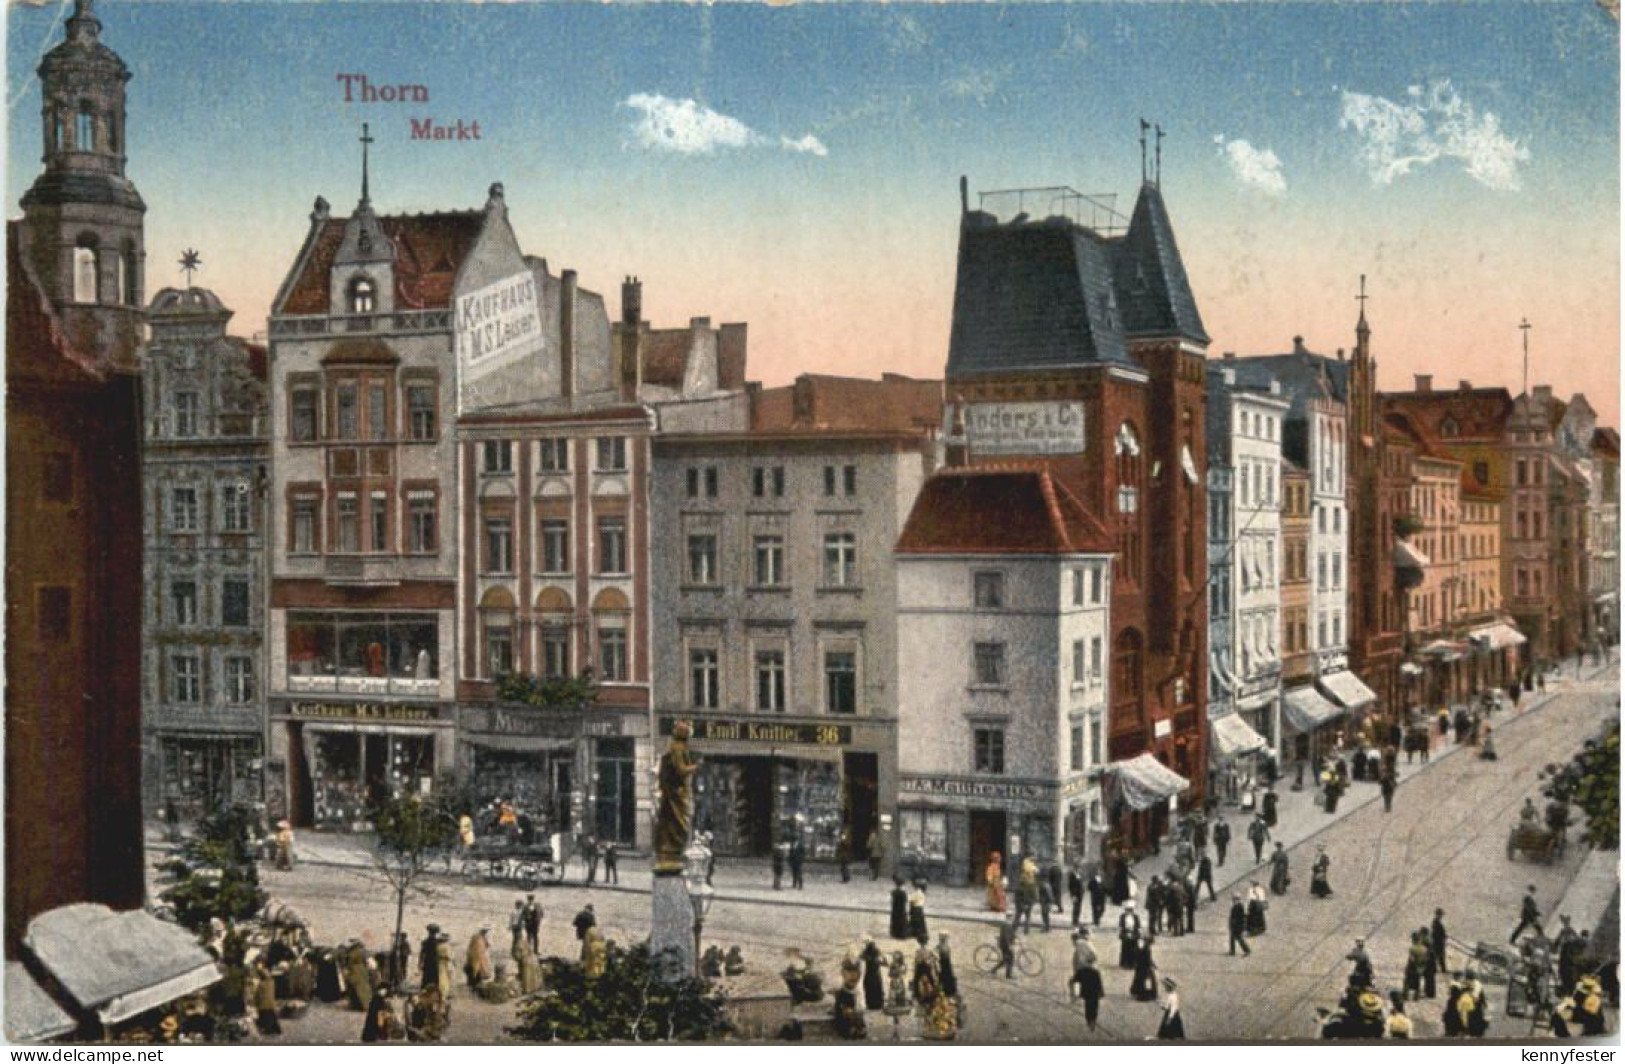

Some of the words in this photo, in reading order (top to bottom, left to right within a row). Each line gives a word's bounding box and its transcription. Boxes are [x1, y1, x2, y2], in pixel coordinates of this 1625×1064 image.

[463, 278, 533, 331] KAUFHAUS
[706, 719, 740, 740] Emil
[816, 724, 839, 745] 36
